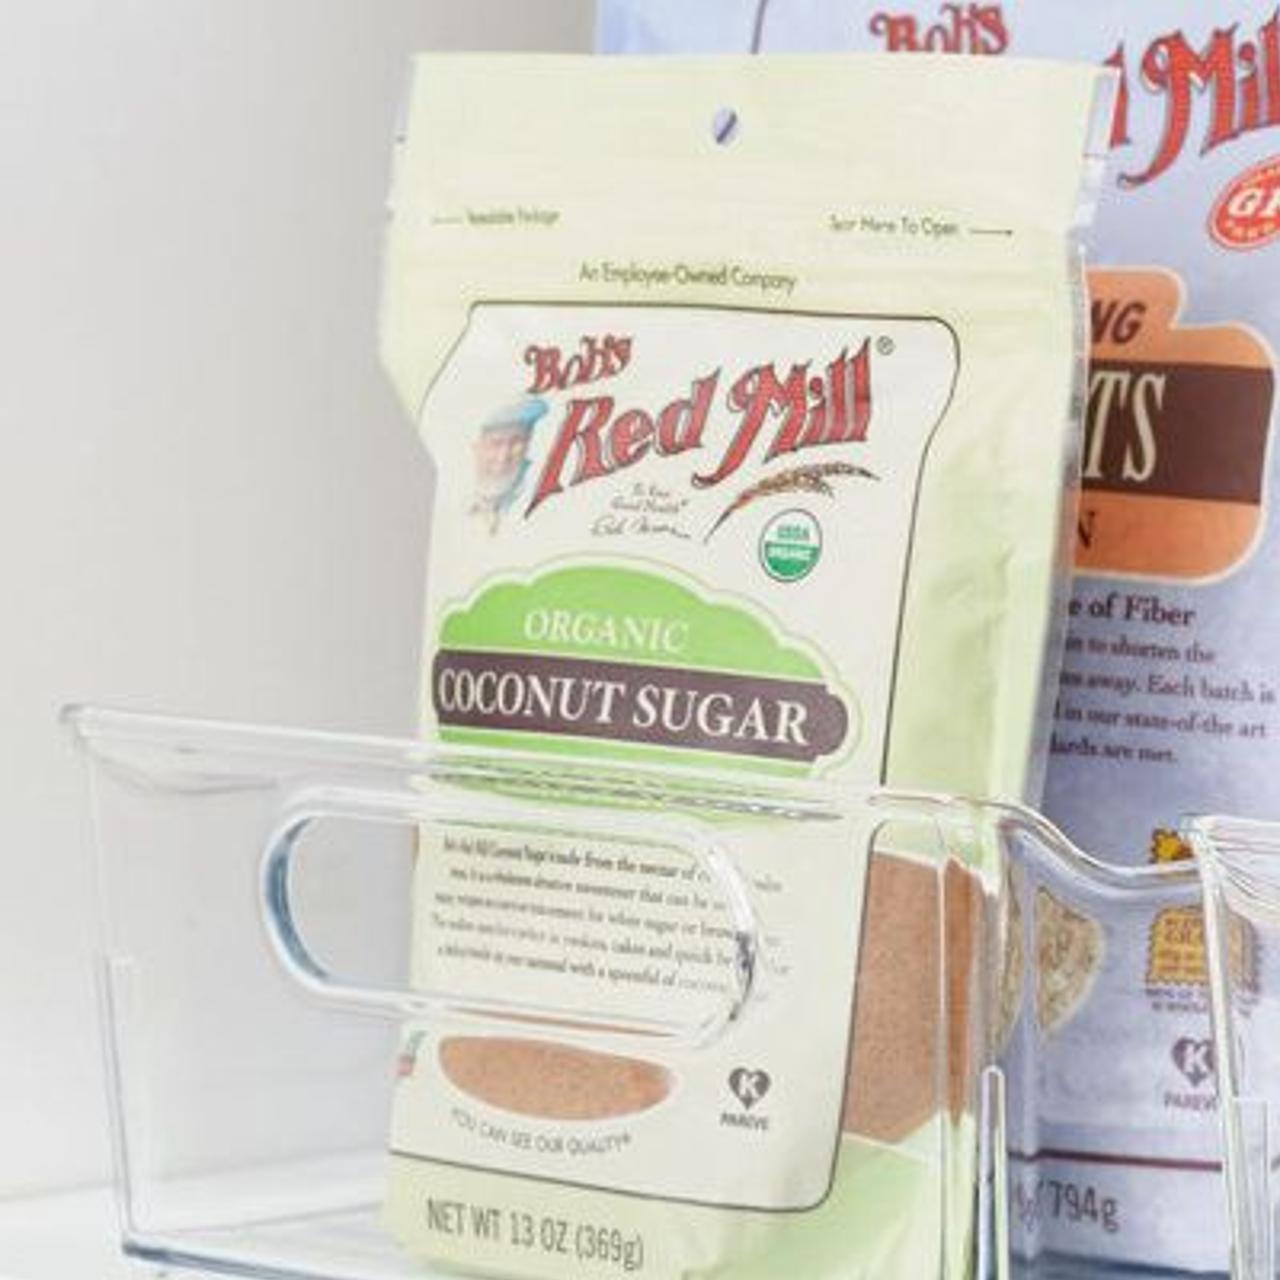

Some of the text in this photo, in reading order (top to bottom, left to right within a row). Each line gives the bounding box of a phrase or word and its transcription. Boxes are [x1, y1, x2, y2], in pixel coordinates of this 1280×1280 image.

[900, 216, 918, 234] To
[923, 219, 958, 238] Open
[579, 261, 599, 282] An
[731, 265, 797, 295] Company
[523, 332, 633, 394] Bob's
[523, 337, 872, 520] Red Mill
[1084, 369, 1167, 483] TS
[1088, 591, 1118, 619] of
[1125, 593, 1198, 628] Fiber
[522, 608, 690, 654] ORGANIC
[1185, 641, 1215, 664] the
[437, 668, 809, 747] COCONUT SUGAR
[1148, 675, 1196, 699] Each
[1201, 678, 1255, 703] batch
[1259, 684, 1276, 704] is
[1239, 719, 1268, 739] art
[511, 1129, 532, 1151] SEE
[535, 1132, 564, 1154] OUR
[427, 1197, 644, 1271] NET WT 13 OZ (369g)
